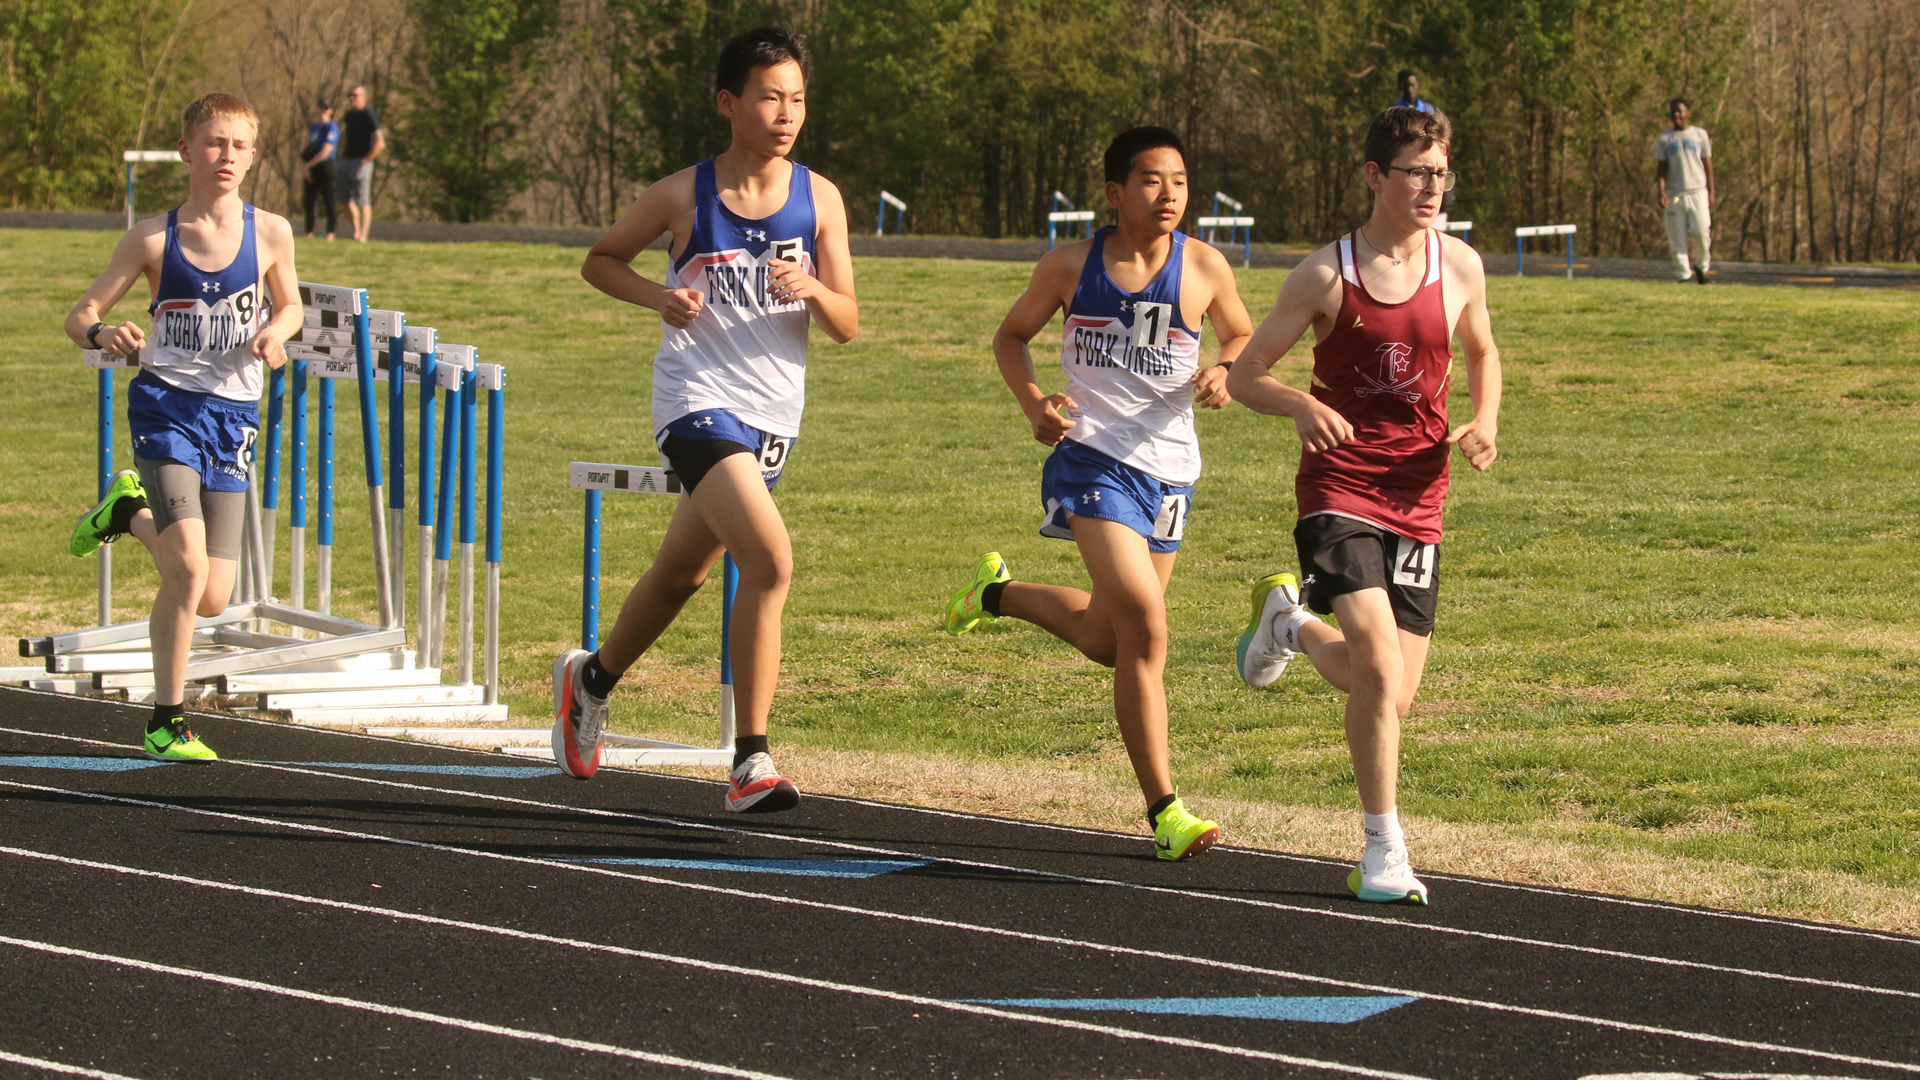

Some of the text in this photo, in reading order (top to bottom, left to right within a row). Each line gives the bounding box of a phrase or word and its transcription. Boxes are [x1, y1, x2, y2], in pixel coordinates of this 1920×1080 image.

[705, 265, 750, 307] FORK
[235, 290, 254, 326] 8
[1144, 306, 1160, 346] 1
[163, 310, 203, 352] FORK
[1074, 326, 1119, 368] FORK
[764, 434, 785, 468] 5
[1166, 498, 1179, 538] 1
[1401, 540, 1426, 584] 4
